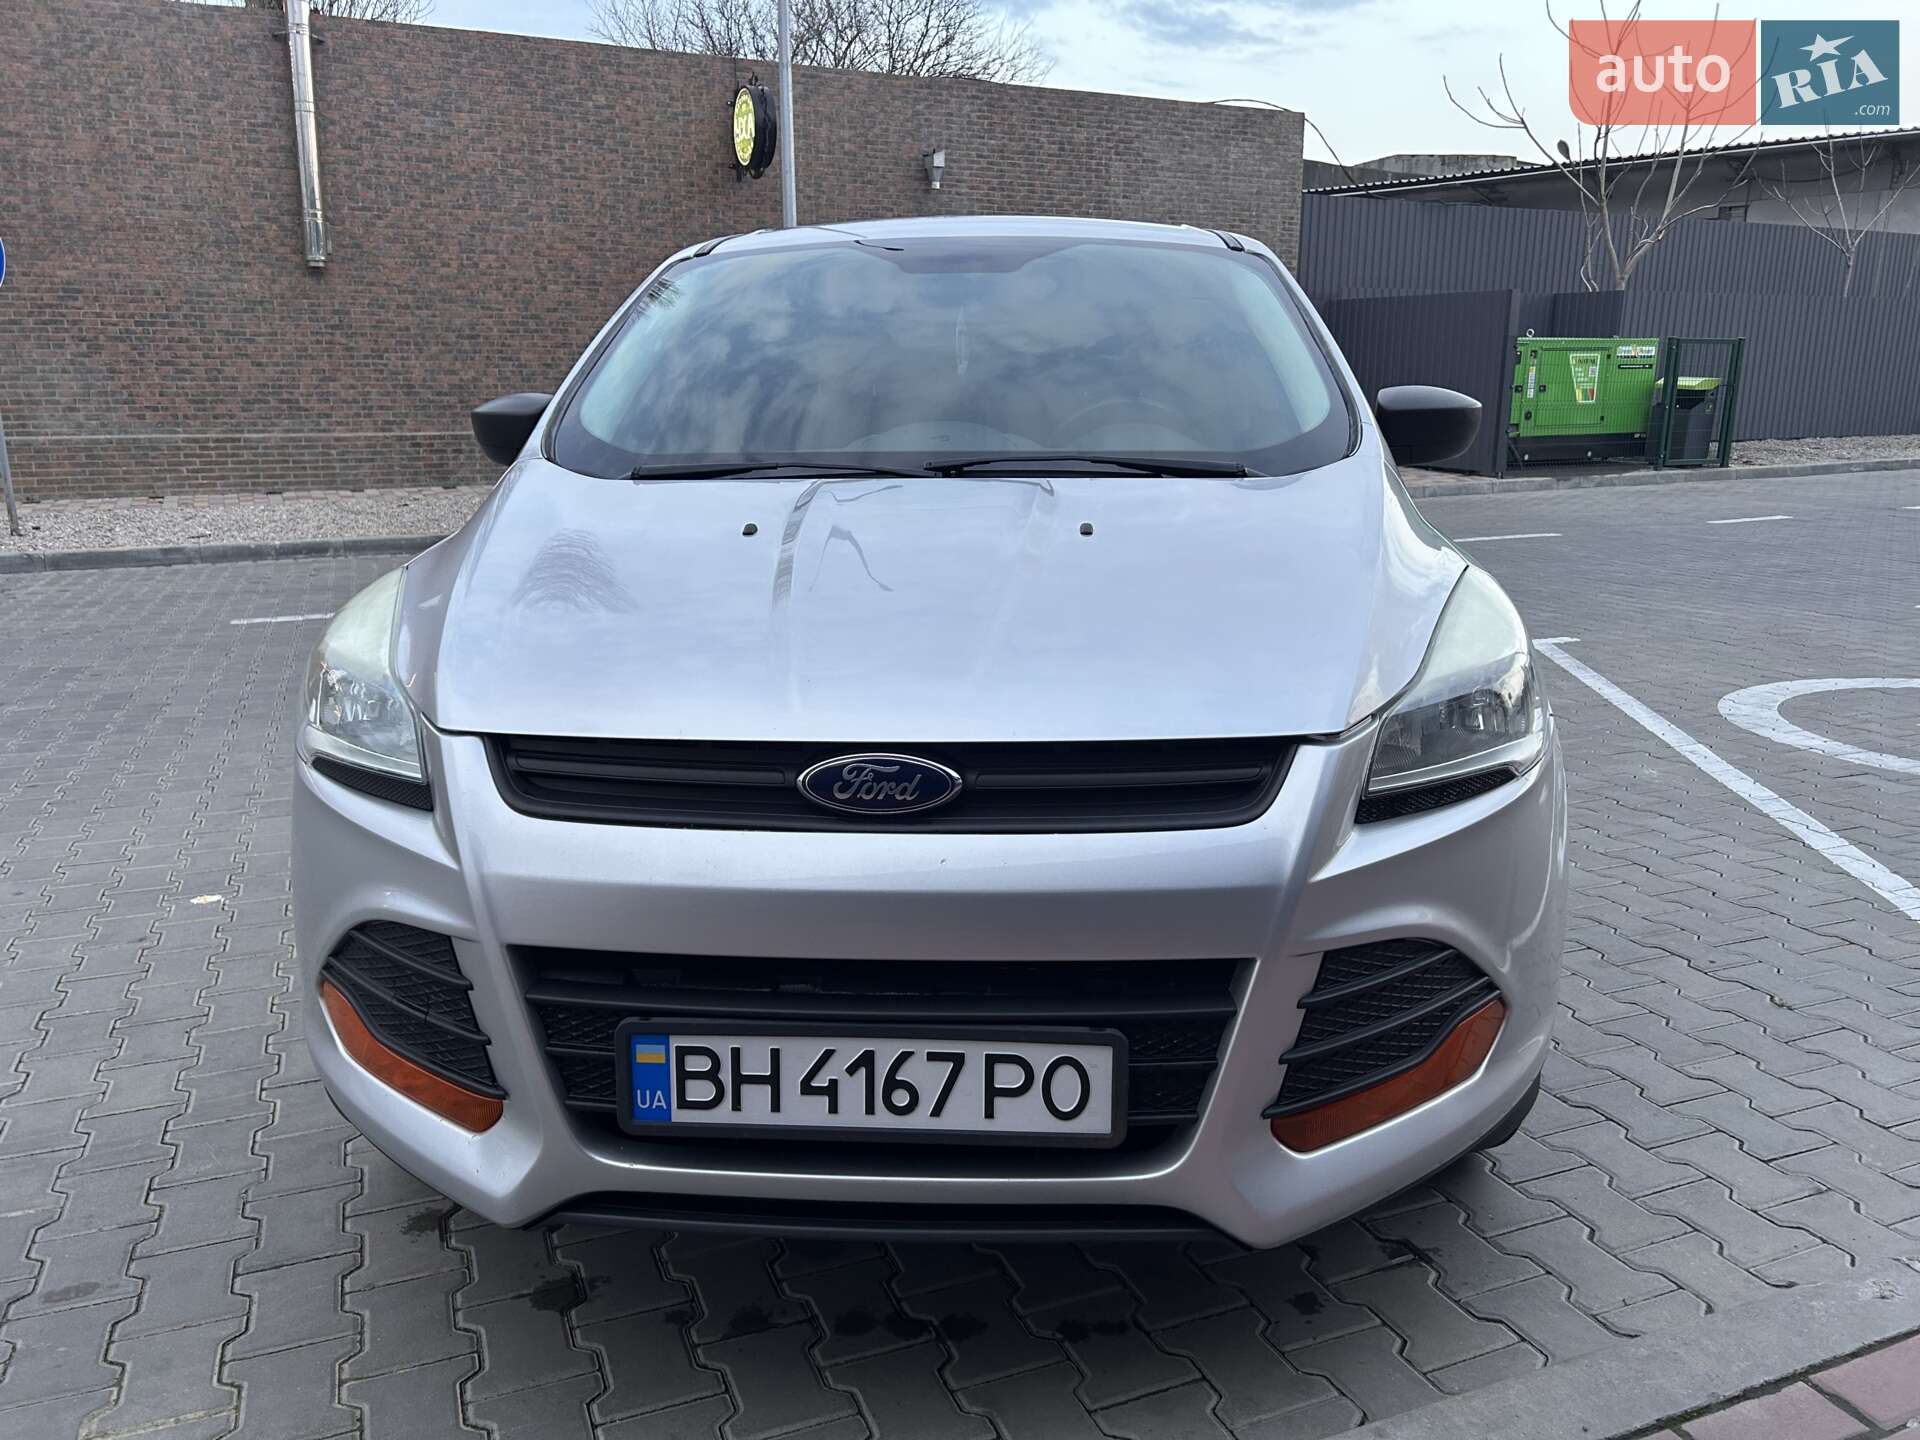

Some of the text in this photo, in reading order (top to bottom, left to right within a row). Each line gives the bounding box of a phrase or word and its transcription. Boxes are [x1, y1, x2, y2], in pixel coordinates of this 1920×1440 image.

[832, 763, 922, 801] Ford
[636, 1089, 667, 1110] UA
[674, 1044, 1091, 1121] BH 4167 PO
